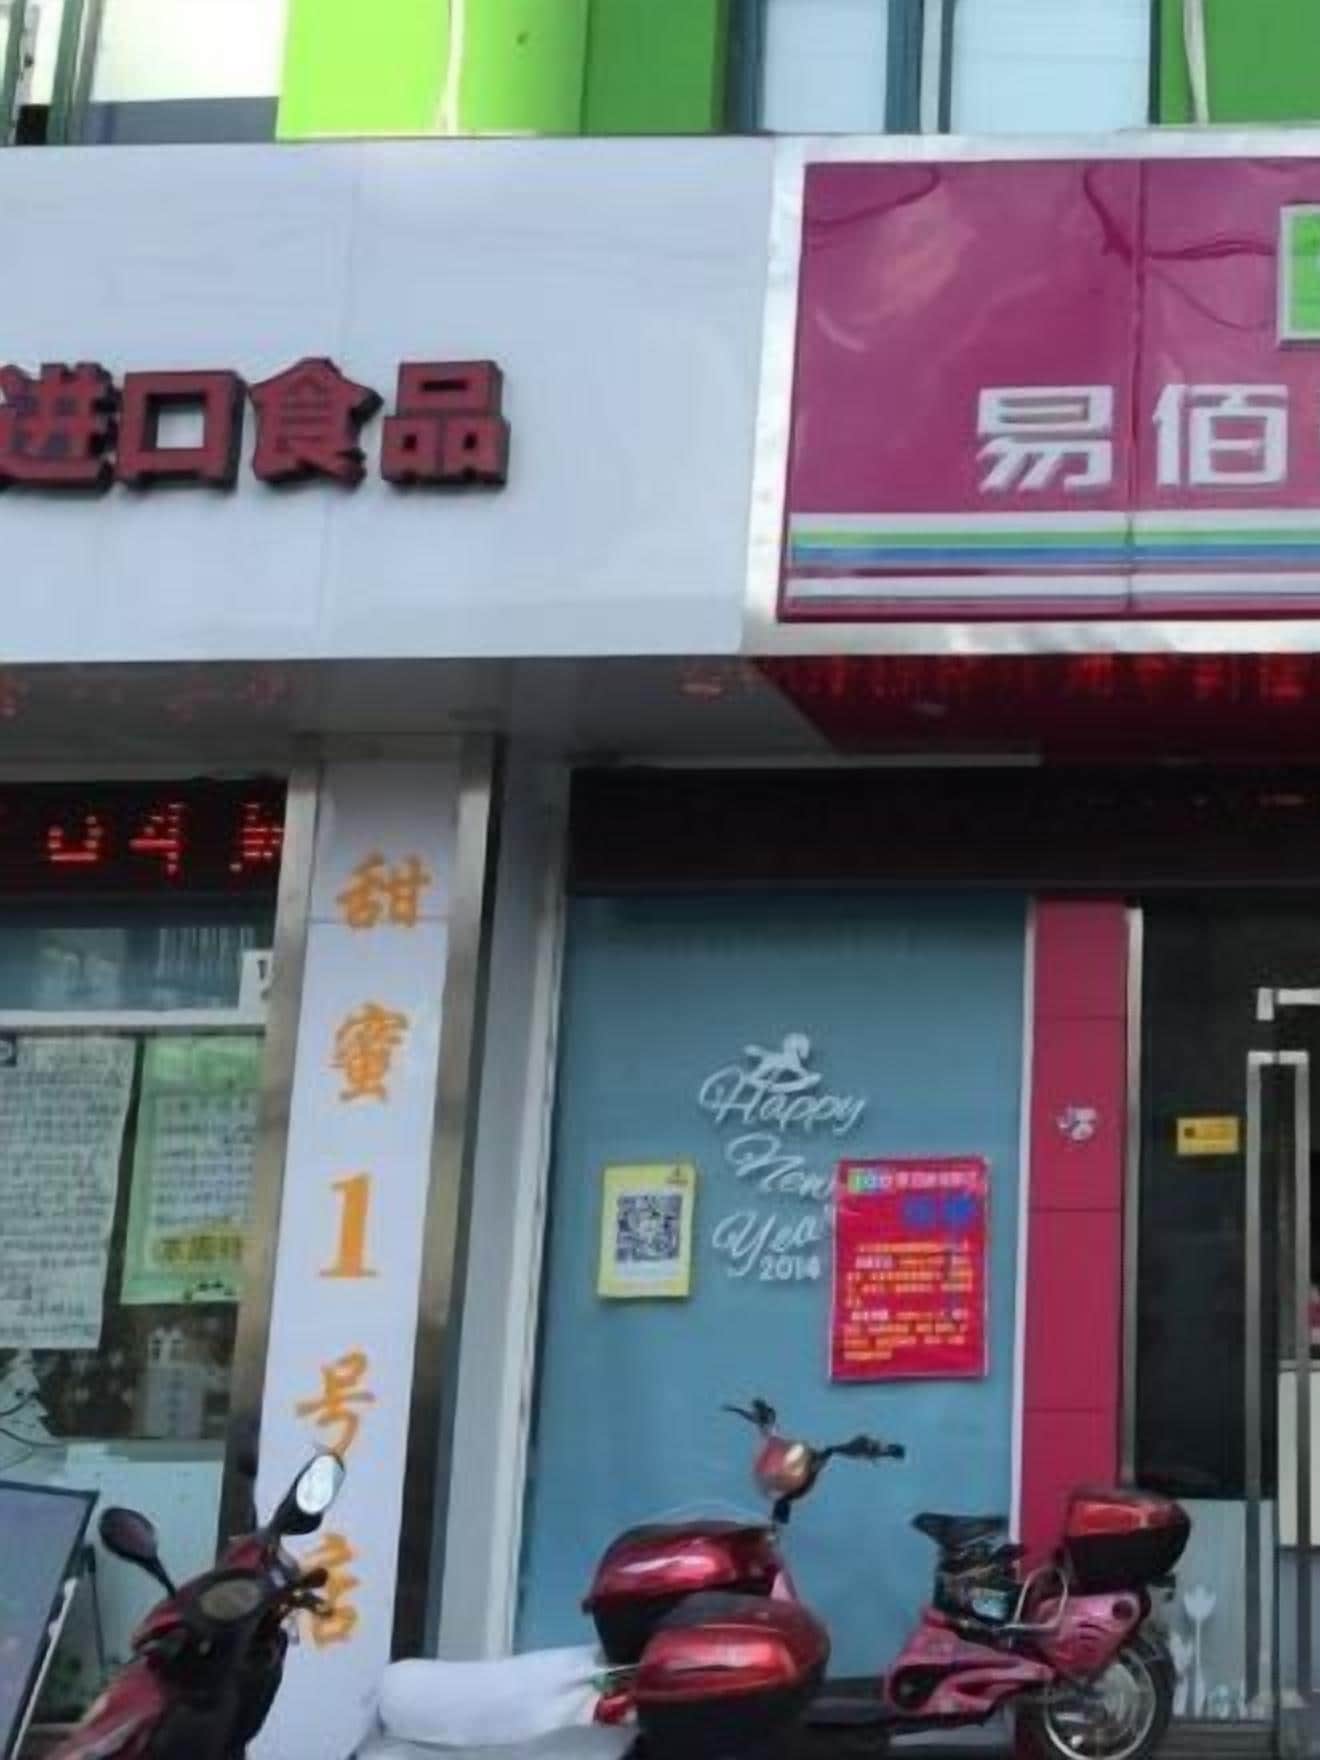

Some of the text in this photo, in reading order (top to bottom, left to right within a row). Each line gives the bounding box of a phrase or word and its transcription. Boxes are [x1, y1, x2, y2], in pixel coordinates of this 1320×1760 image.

[0, 357, 511, 493] 进口食品
[699, 1066, 866, 1134] Happy
[711, 1204, 831, 1277] Yea
[759, 1256, 821, 1281] 2014
